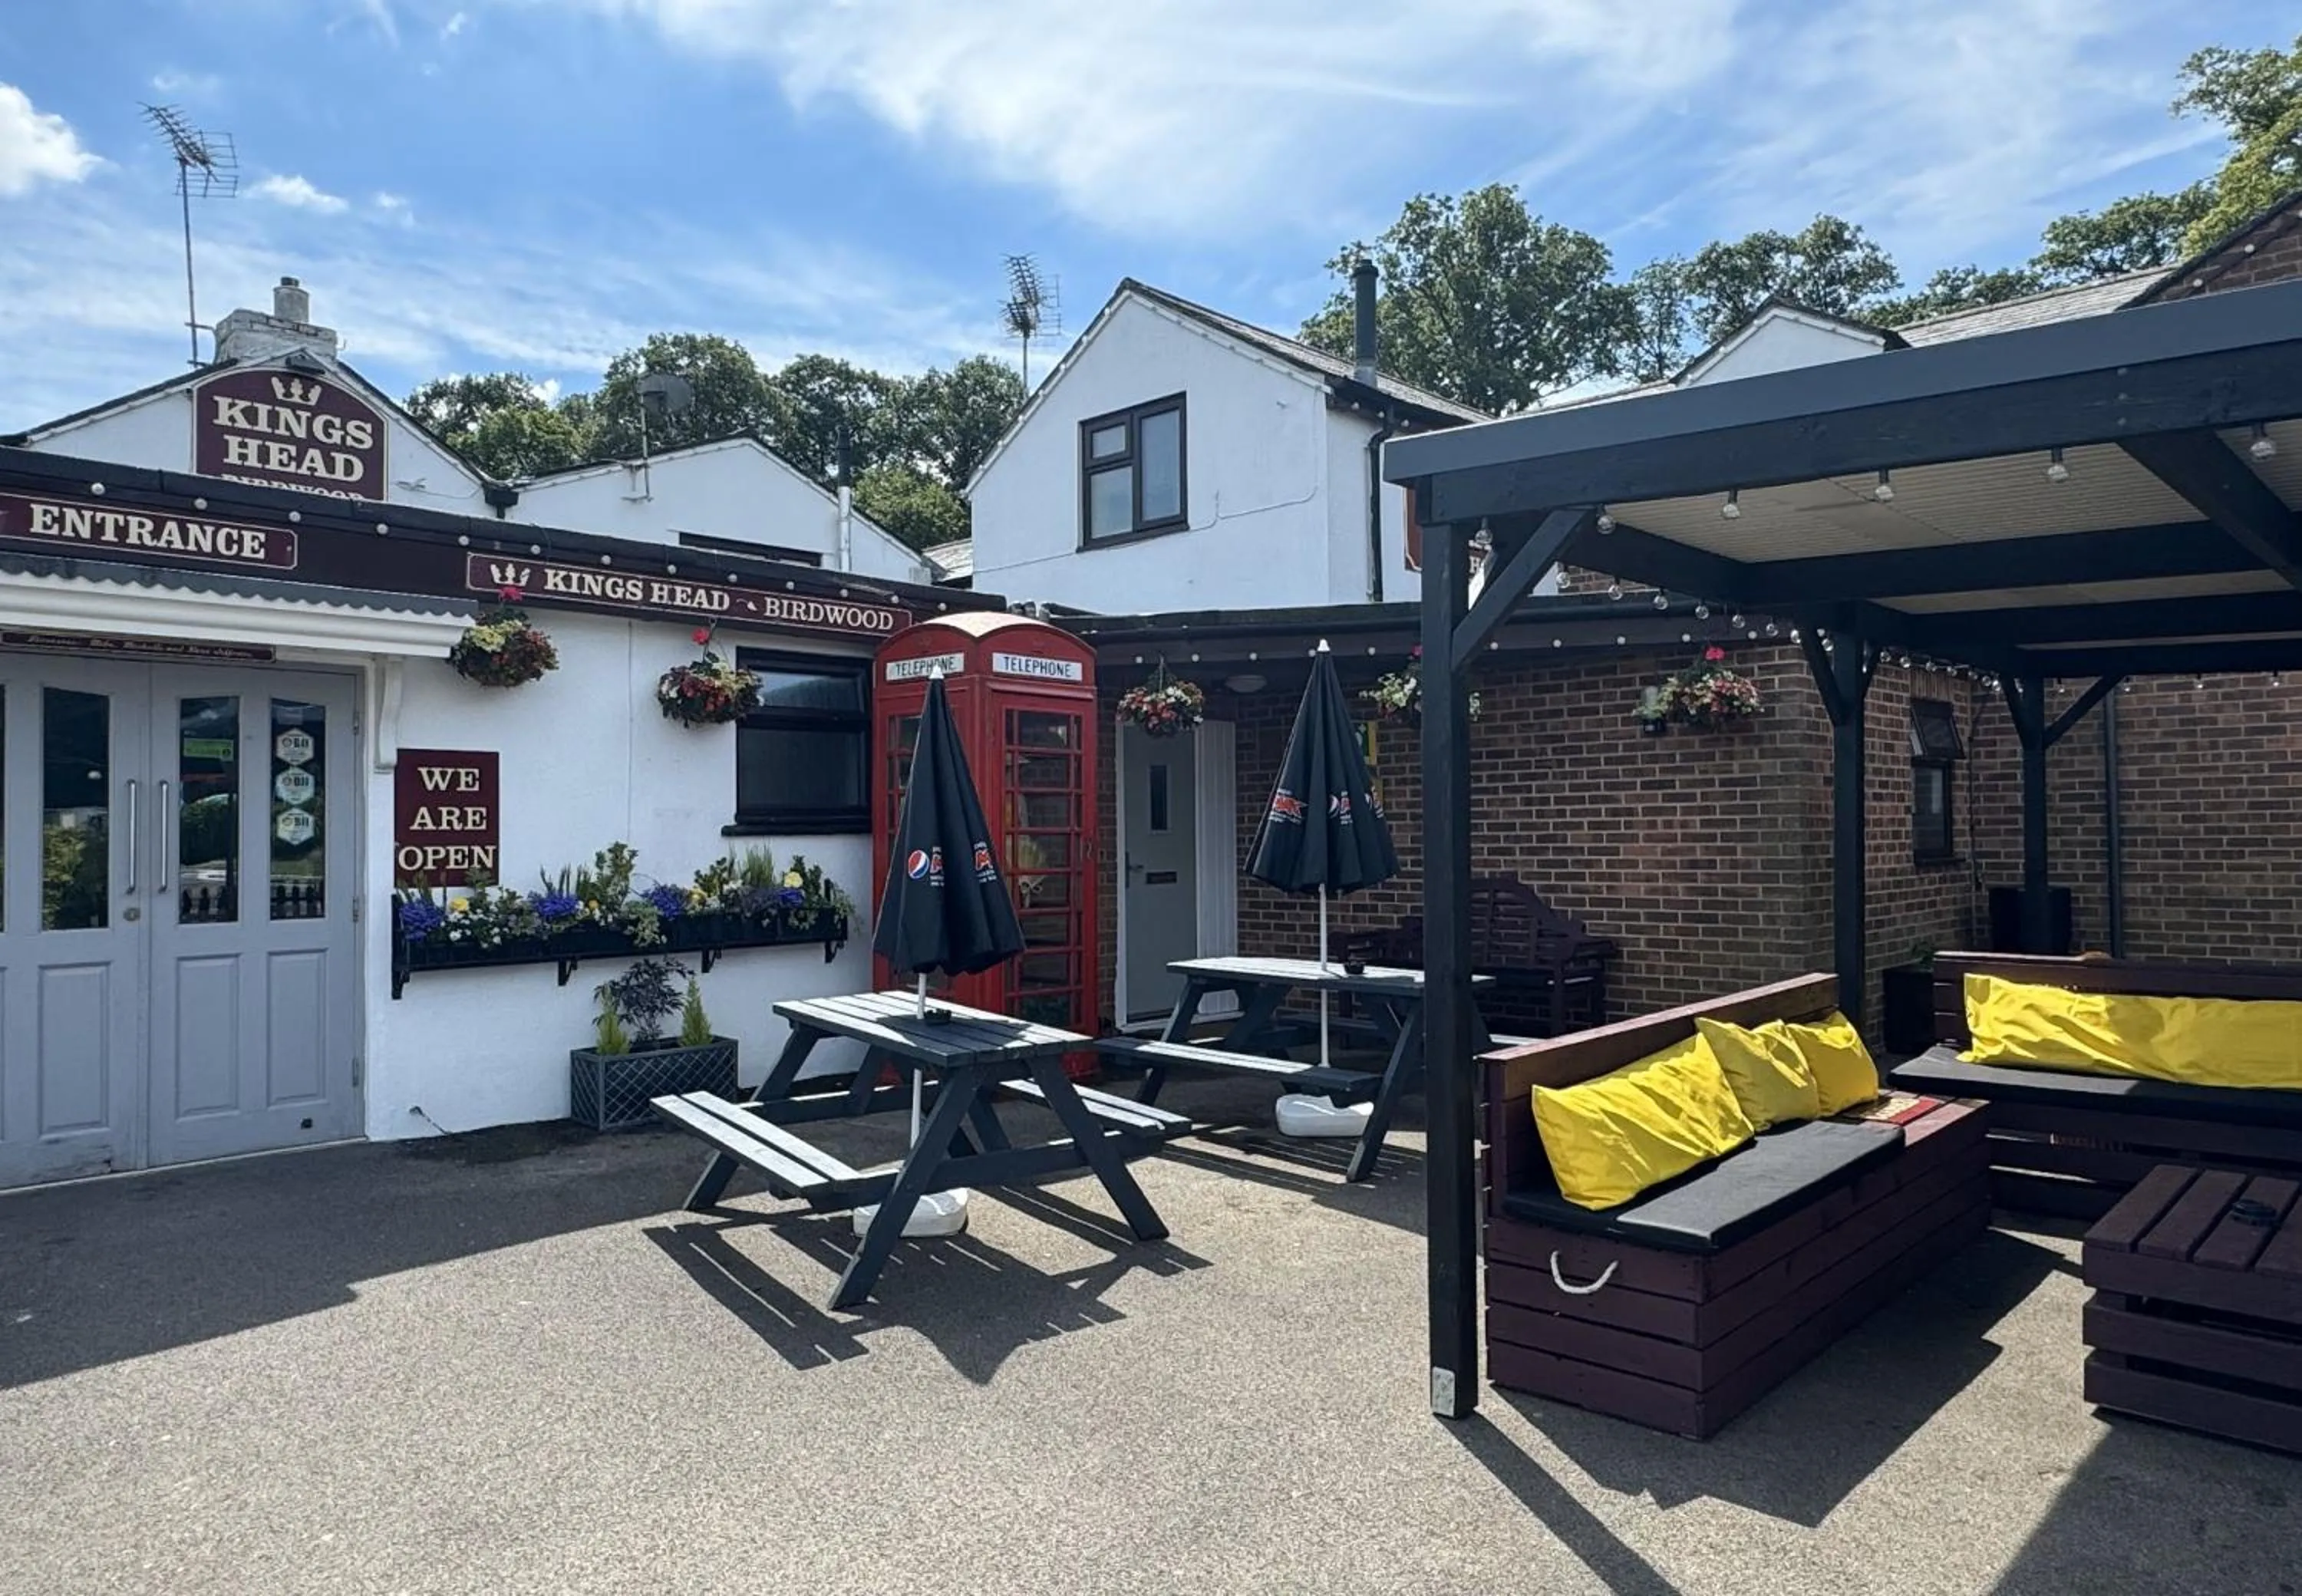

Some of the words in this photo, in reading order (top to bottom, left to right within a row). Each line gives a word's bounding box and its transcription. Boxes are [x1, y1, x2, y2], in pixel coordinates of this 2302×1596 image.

[213, 395, 374, 450] KINGS
[223, 434, 364, 483] HEAD
[30, 503, 266, 560] ENTRANCE
[544, 569, 644, 602] KINGS
[650, 582, 730, 612] HEAD
[764, 597, 894, 631] BIRDWOOD
[1004, 656, 1072, 678] TELEPHONE
[417, 767, 480, 791] WE
[409, 806, 487, 831] ARE
[398, 845, 496, 871] OPEN
